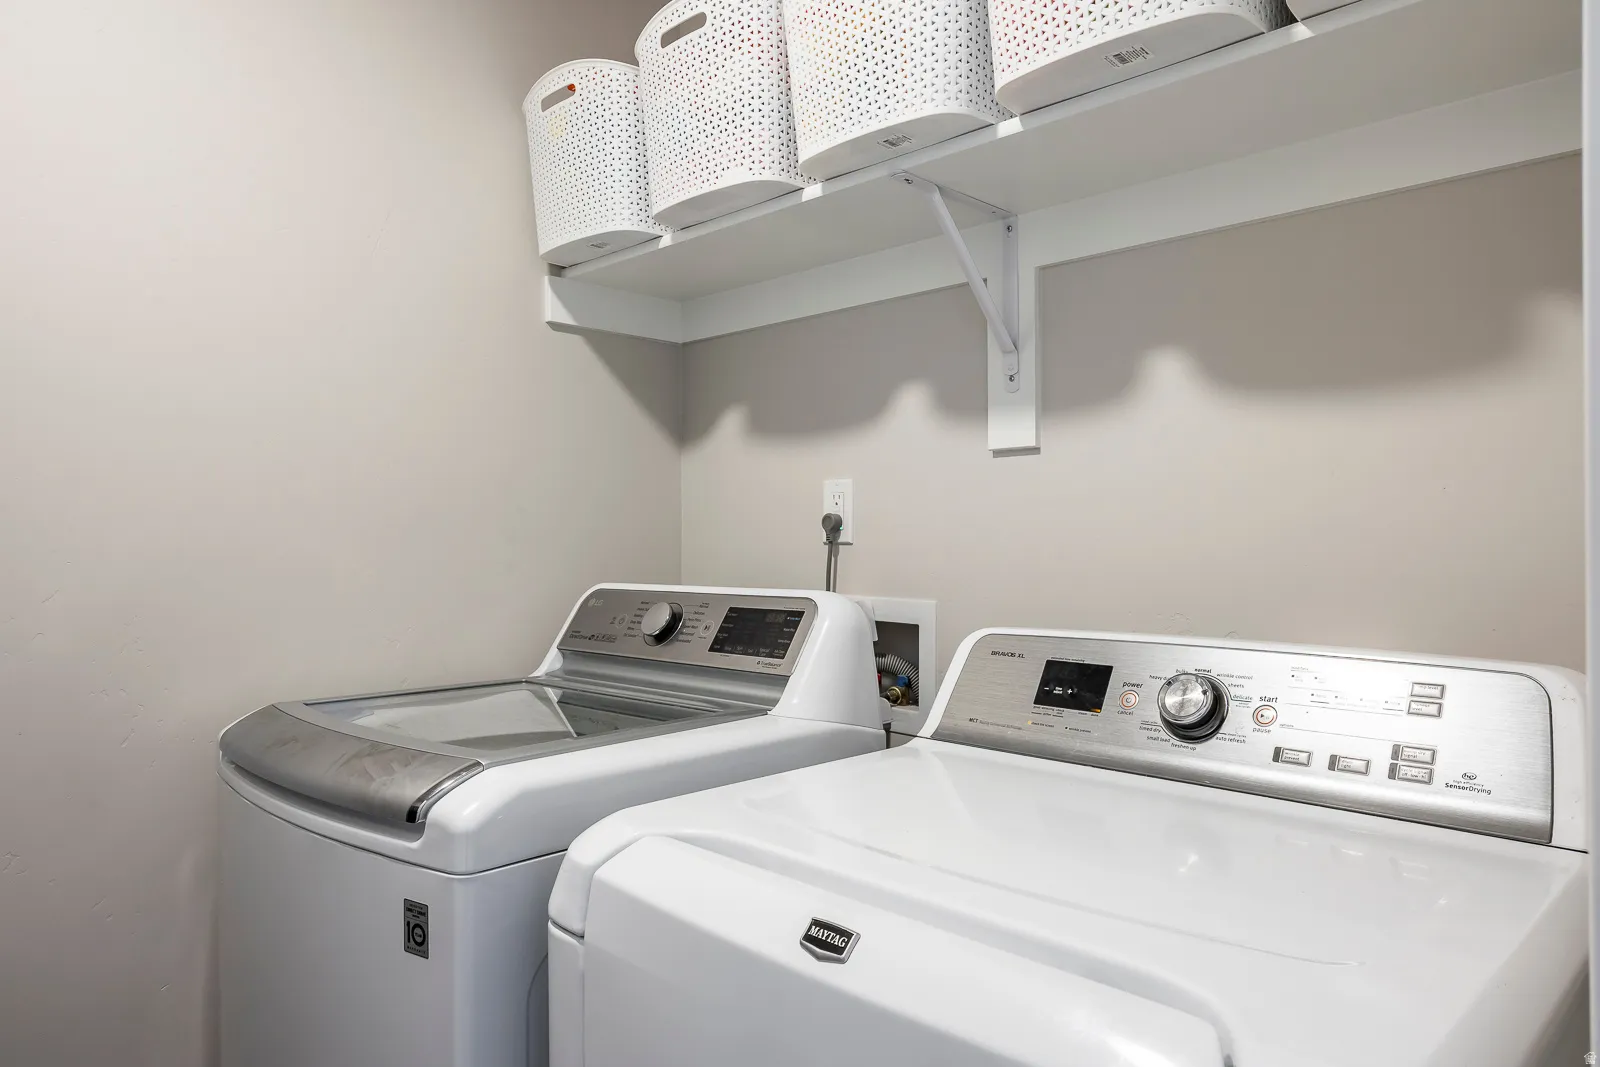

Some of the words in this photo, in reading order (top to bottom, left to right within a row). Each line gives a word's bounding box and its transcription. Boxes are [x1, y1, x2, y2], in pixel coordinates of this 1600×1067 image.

[990, 650, 1016, 658] BRAVOS
[1122, 681, 1143, 689] power
[1445, 782, 1492, 796] SensorDrying
[807, 925, 848, 947] MAYTAG
